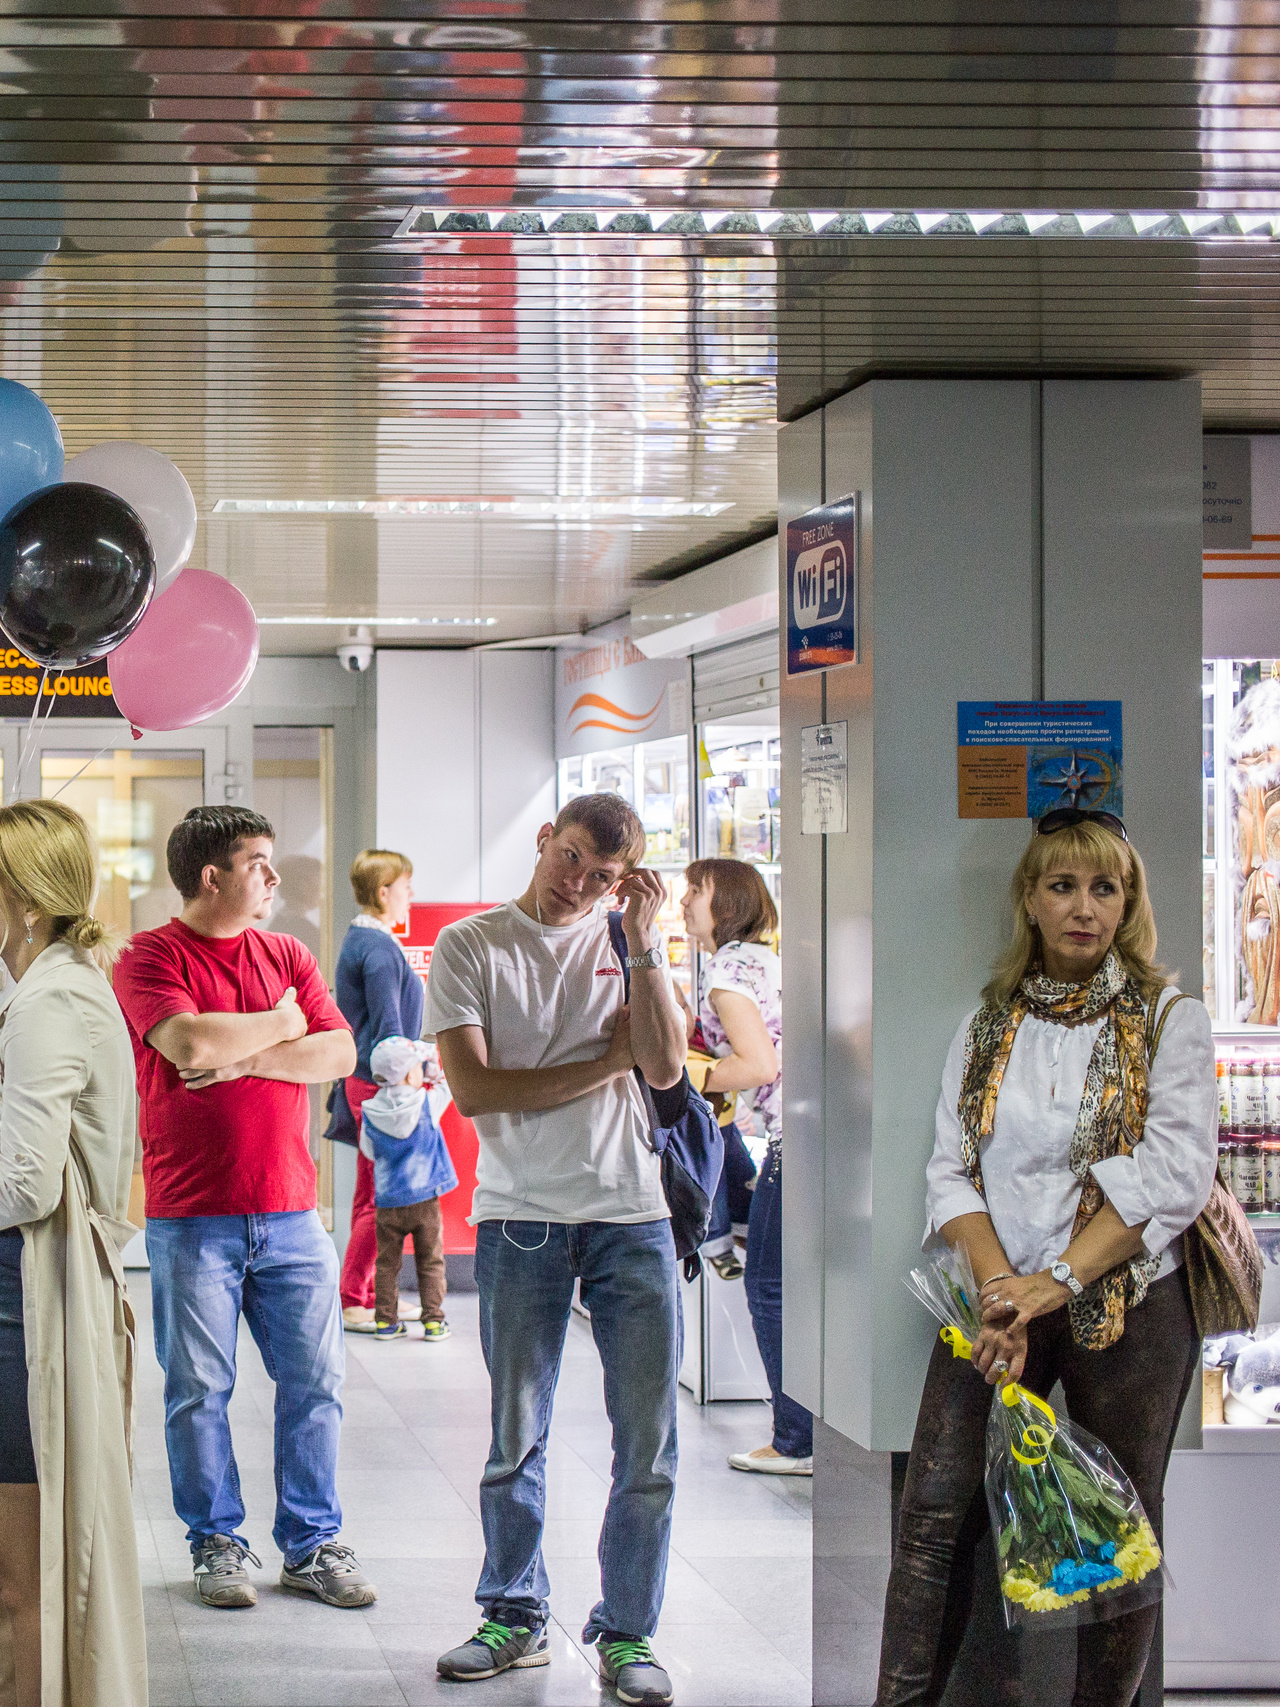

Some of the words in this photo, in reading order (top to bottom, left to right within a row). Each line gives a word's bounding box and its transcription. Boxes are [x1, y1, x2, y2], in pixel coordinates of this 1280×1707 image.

[1203, 499, 1243, 507] осуточно
[802, 528, 816, 546] FREE
[817, 521, 834, 542] ZONE
[42, 676, 114, 696] LOUNG
[984, 720, 998, 728] При
[997, 728, 1039, 736] необходимо
[1040, 728, 1064, 736] пройти
